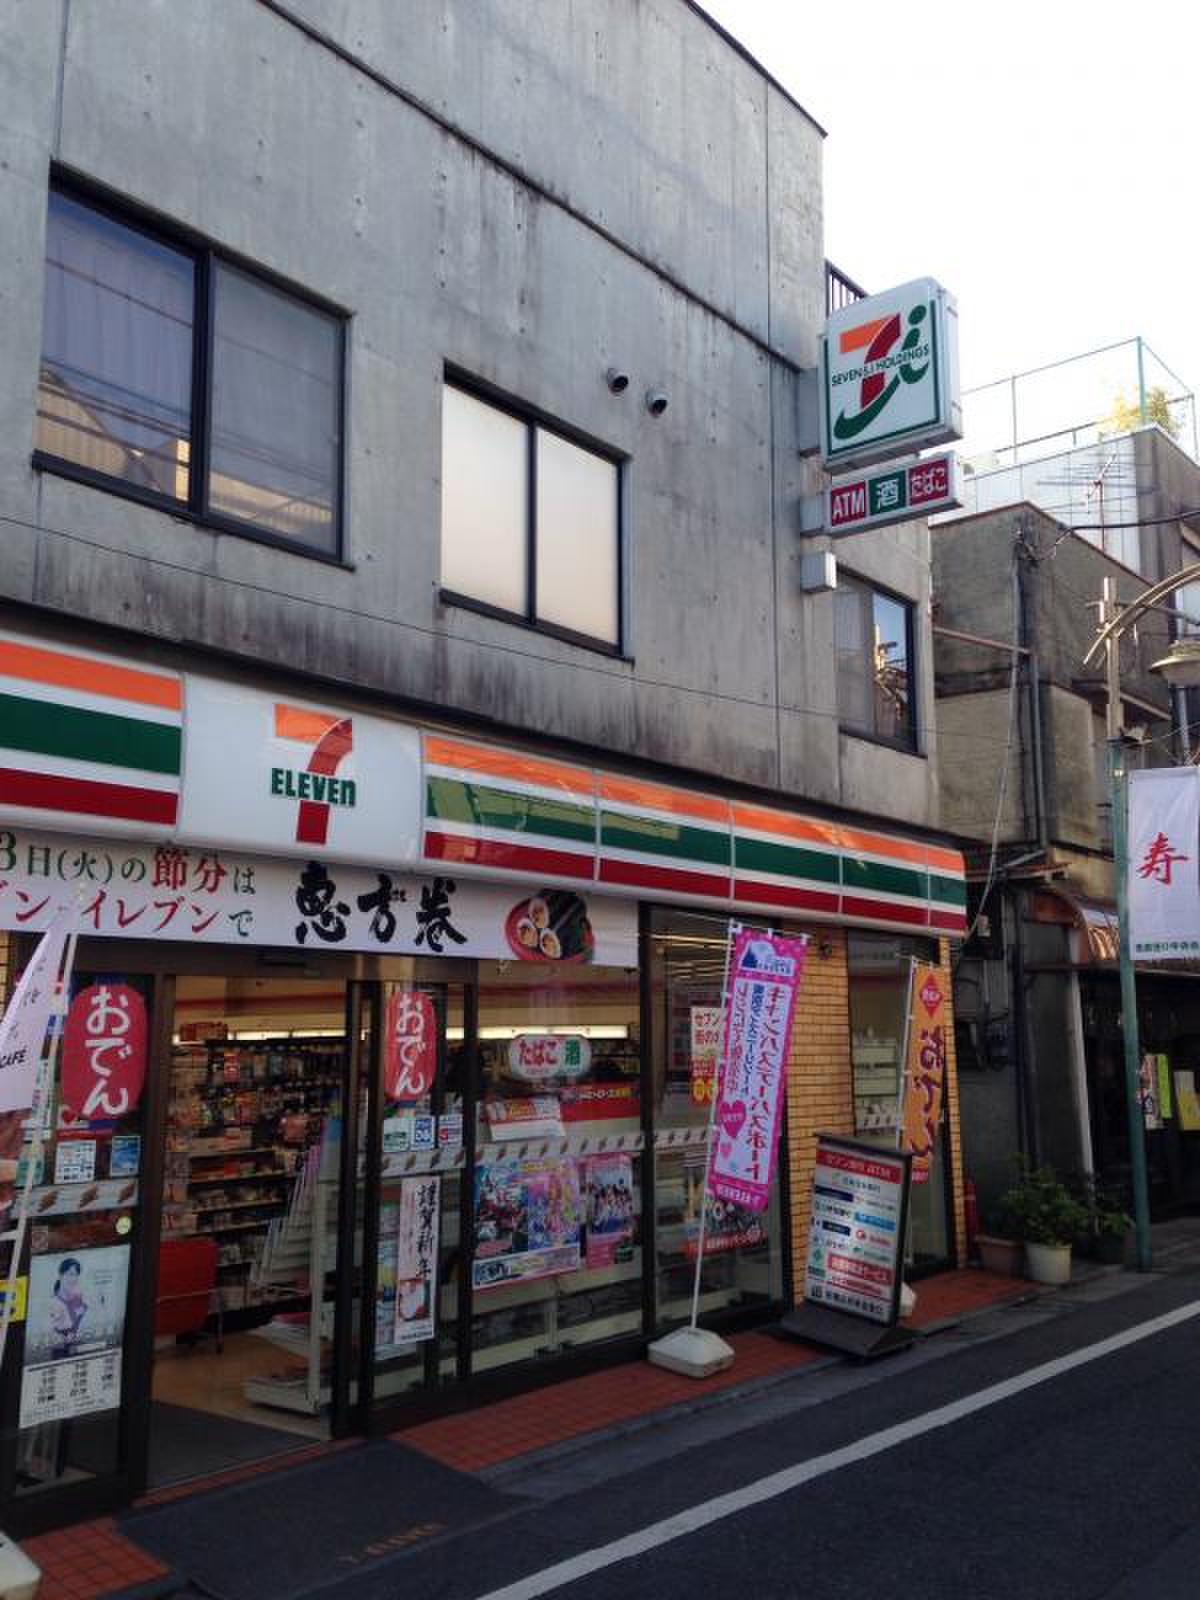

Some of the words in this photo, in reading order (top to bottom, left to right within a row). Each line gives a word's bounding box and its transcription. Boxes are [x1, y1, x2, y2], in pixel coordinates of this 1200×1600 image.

[833, 487, 865, 519] ATM
[876, 478, 899, 510] 酒
[910, 466, 947, 498] たばこ
[1136, 831, 1190, 886] 寿
[85, 984, 131, 1117] おでん
[396, 993, 425, 1095] おでん
[518, 1040, 557, 1067] たばこ
